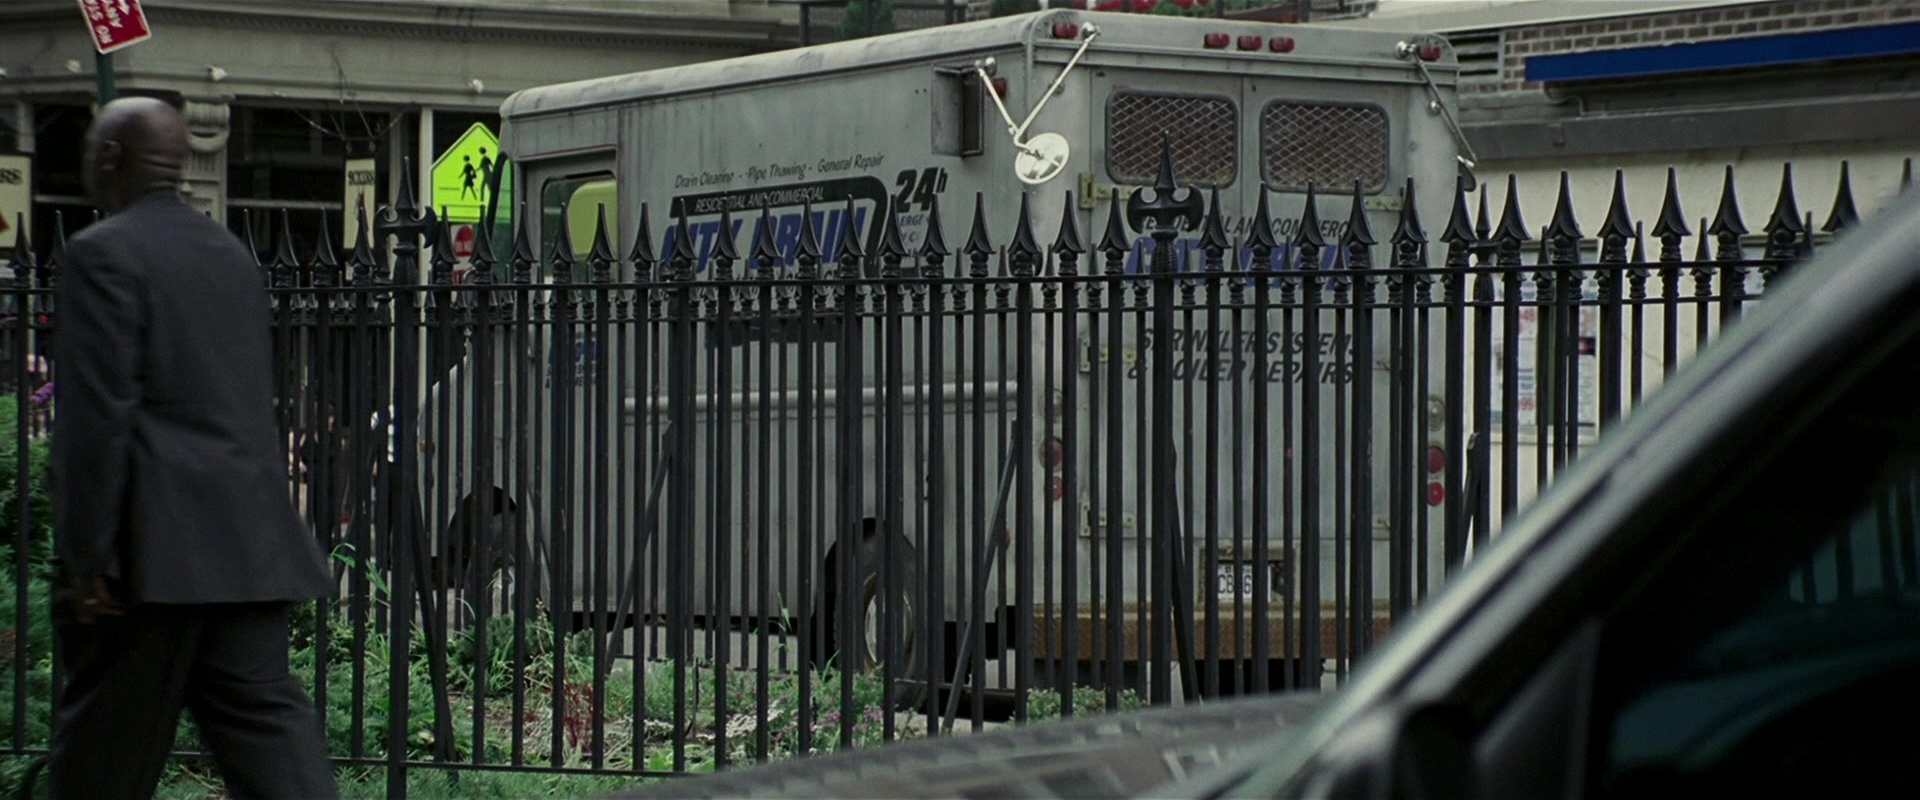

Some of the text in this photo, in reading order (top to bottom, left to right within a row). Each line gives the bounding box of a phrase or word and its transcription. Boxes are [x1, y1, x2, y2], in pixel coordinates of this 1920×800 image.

[675, 173, 698, 188] Drain
[747, 165, 767, 184] Pipe
[769, 162, 807, 181] Thawing
[817, 155, 852, 173] General
[853, 152, 885, 172] Repair
